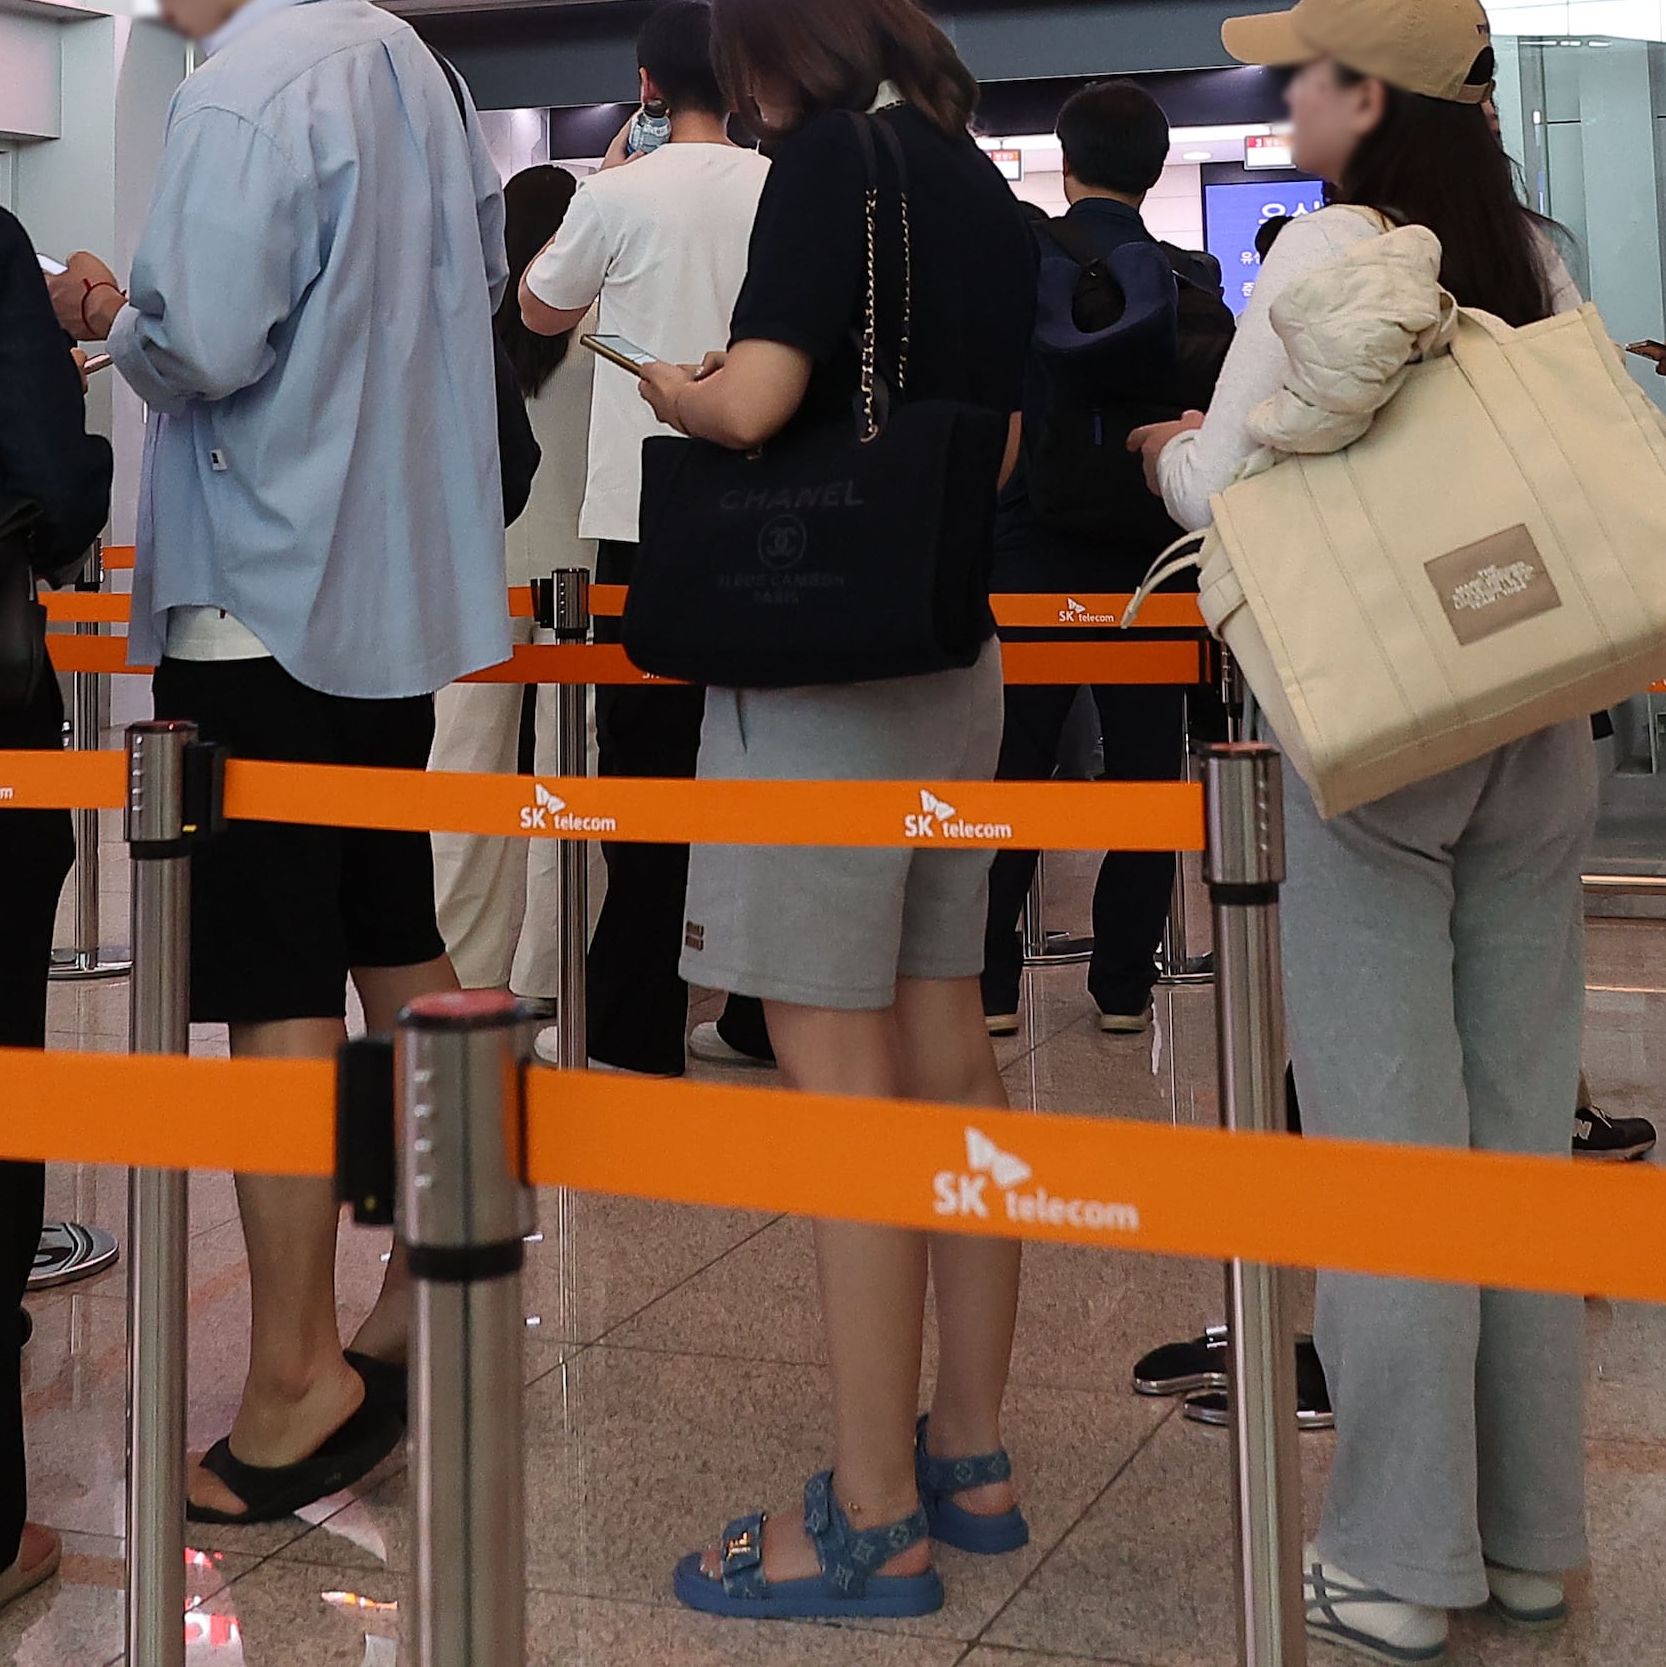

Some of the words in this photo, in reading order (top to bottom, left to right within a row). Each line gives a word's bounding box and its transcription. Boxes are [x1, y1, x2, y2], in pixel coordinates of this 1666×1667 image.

[717, 478, 864, 511] CHANEL
[1059, 611, 1075, 623] SK
[1078, 612, 1114, 624] telecom
[520, 805, 546, 829] SK
[553, 811, 617, 832] telecom
[904, 813, 934, 838] SK
[942, 818, 1013, 839] telecom
[933, 1172, 989, 1218] SK
[1005, 1188, 1139, 1231] telecom
